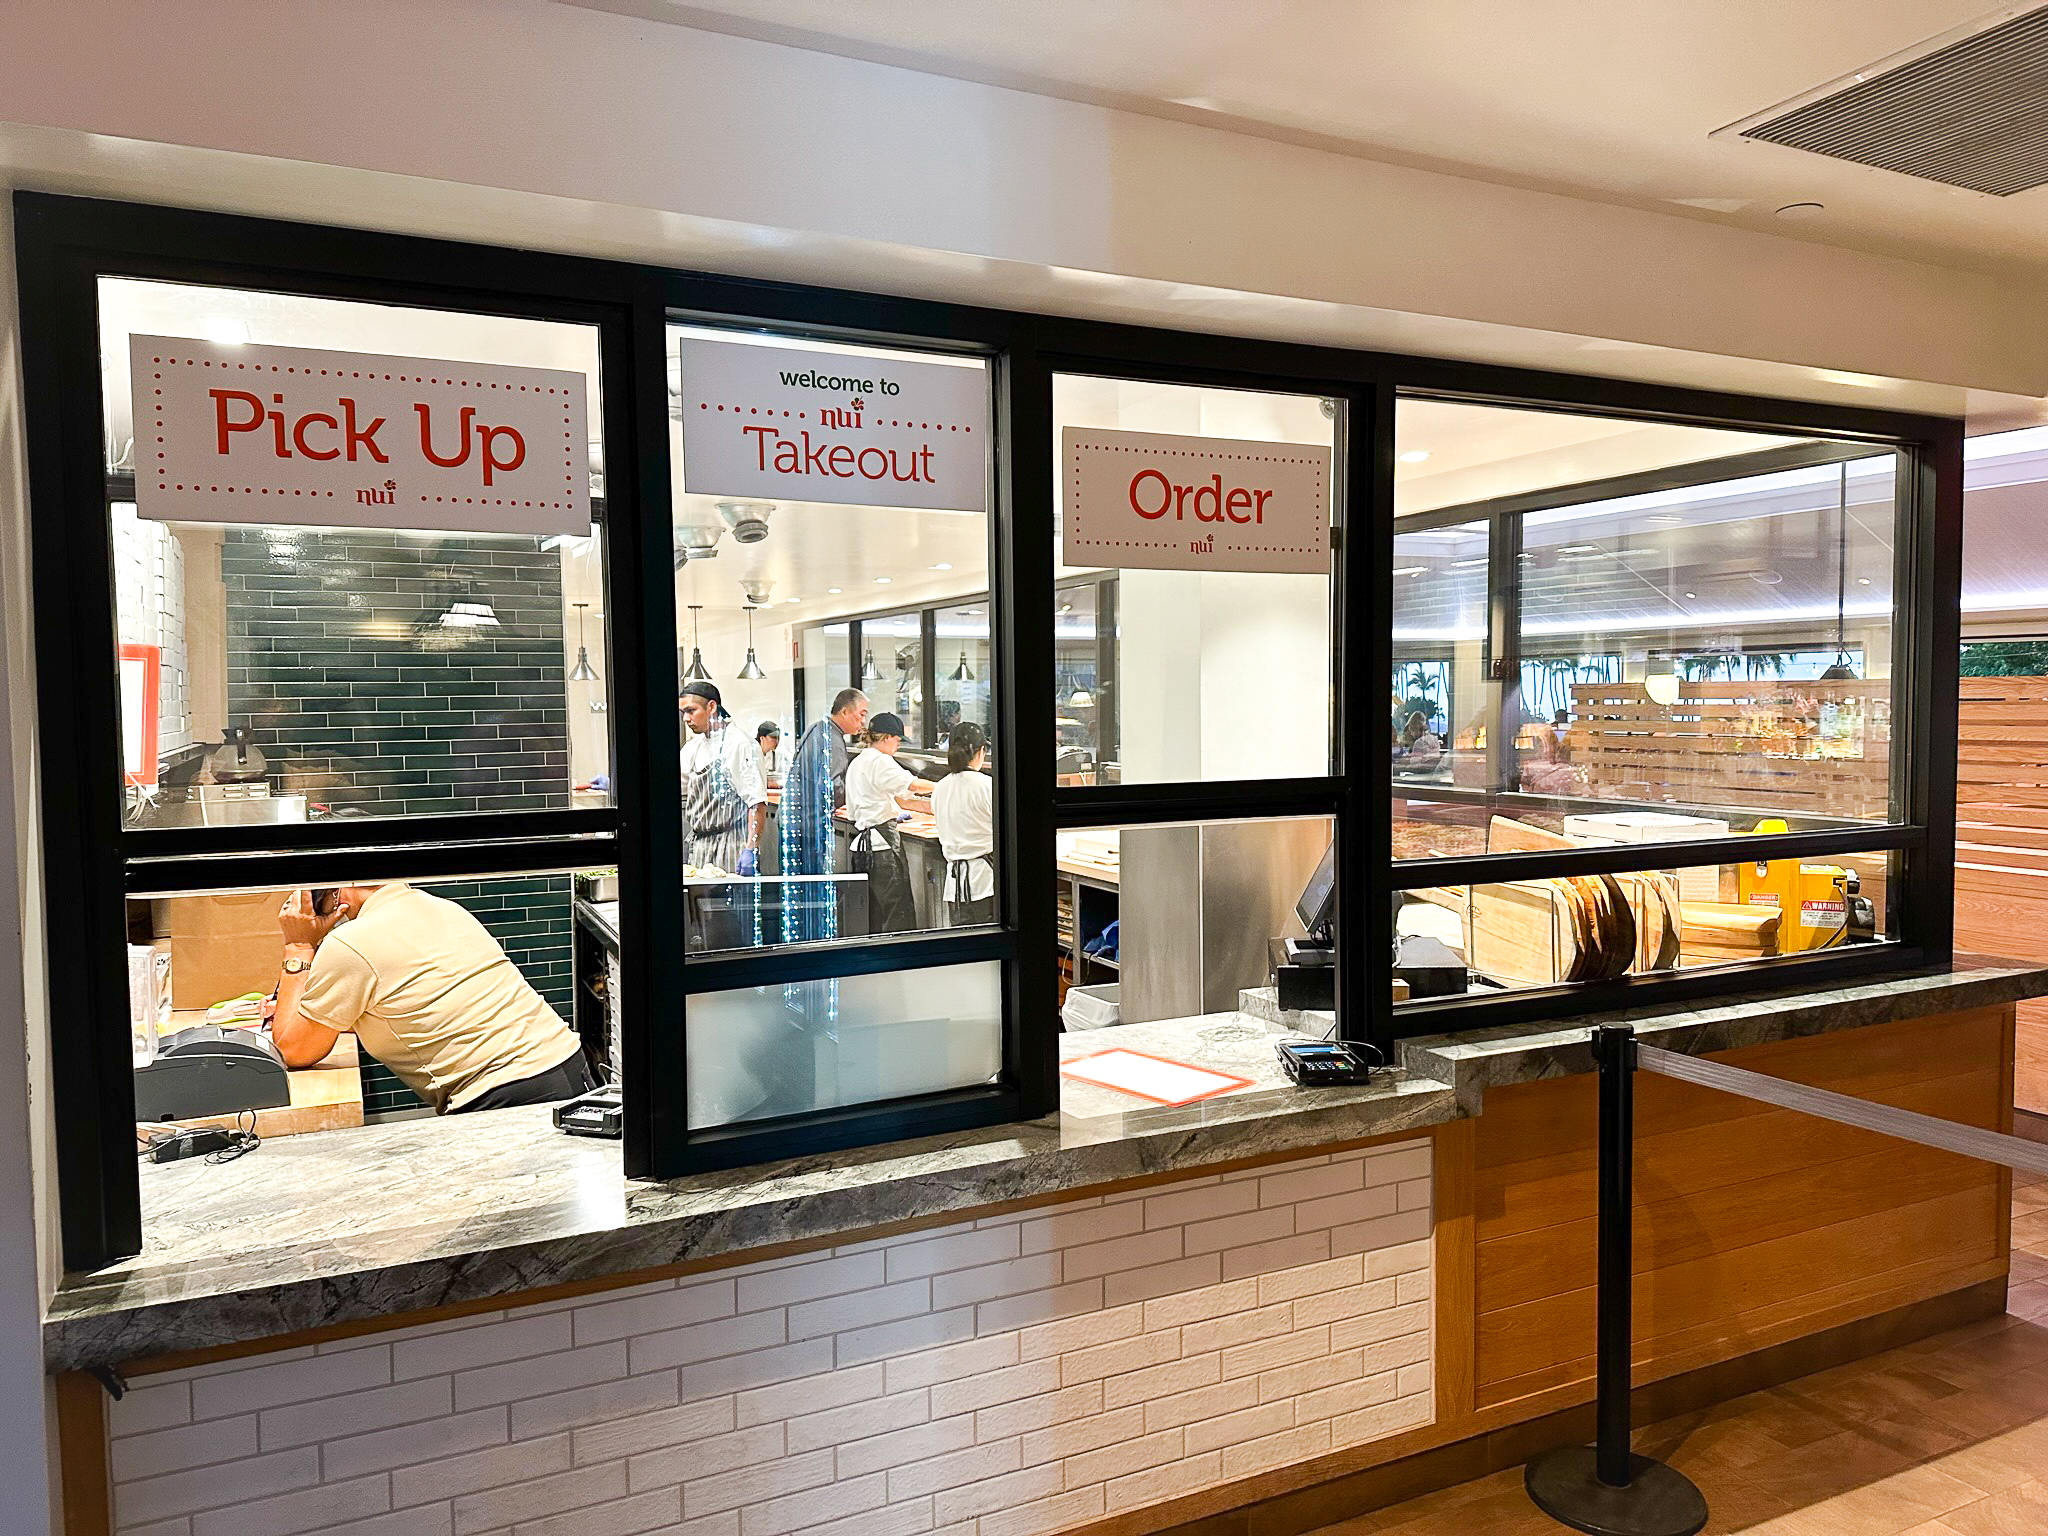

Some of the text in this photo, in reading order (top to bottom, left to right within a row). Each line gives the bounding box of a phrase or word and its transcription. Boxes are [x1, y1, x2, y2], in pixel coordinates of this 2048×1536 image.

[779, 370, 900, 396] welcome to
[820, 398, 865, 430] nui
[208, 388, 526, 486] Pick Up
[743, 425, 936, 483] Takeout
[356, 480, 396, 506] nui
[1128, 468, 1273, 524] Order
[1190, 534, 1214, 555] nui
[1811, 902, 1844, 911] WARNING
